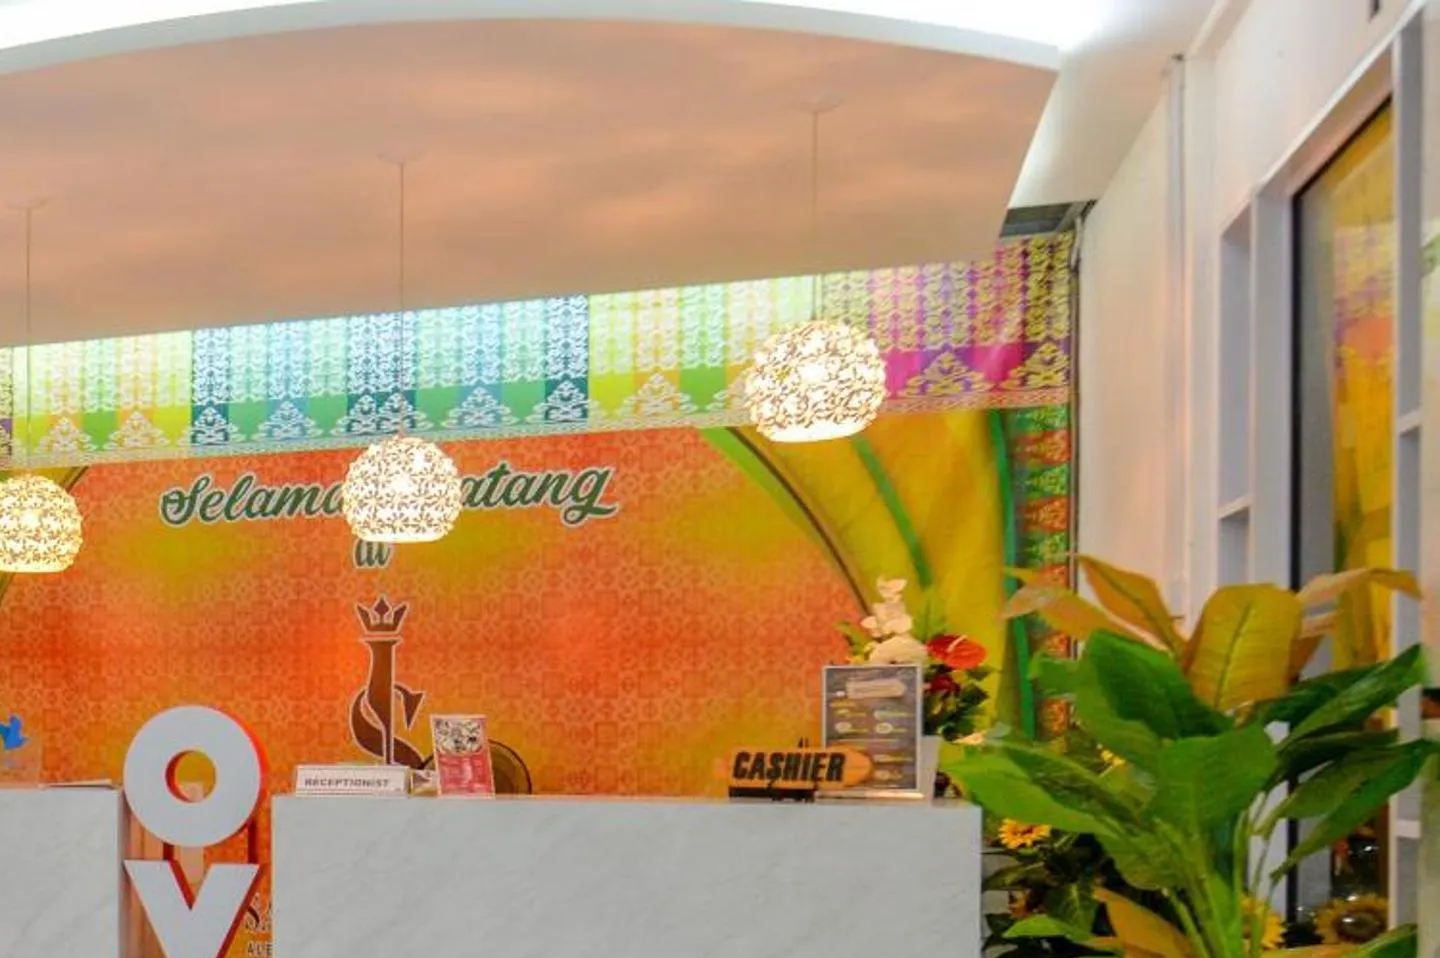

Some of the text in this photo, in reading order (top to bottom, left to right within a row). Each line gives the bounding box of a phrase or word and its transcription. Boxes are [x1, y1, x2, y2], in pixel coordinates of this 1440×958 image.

[161, 461, 618, 526] Selama atang
[732, 751, 846, 782] CASHIER
[304, 777, 390, 789] RECEPTIONIST
